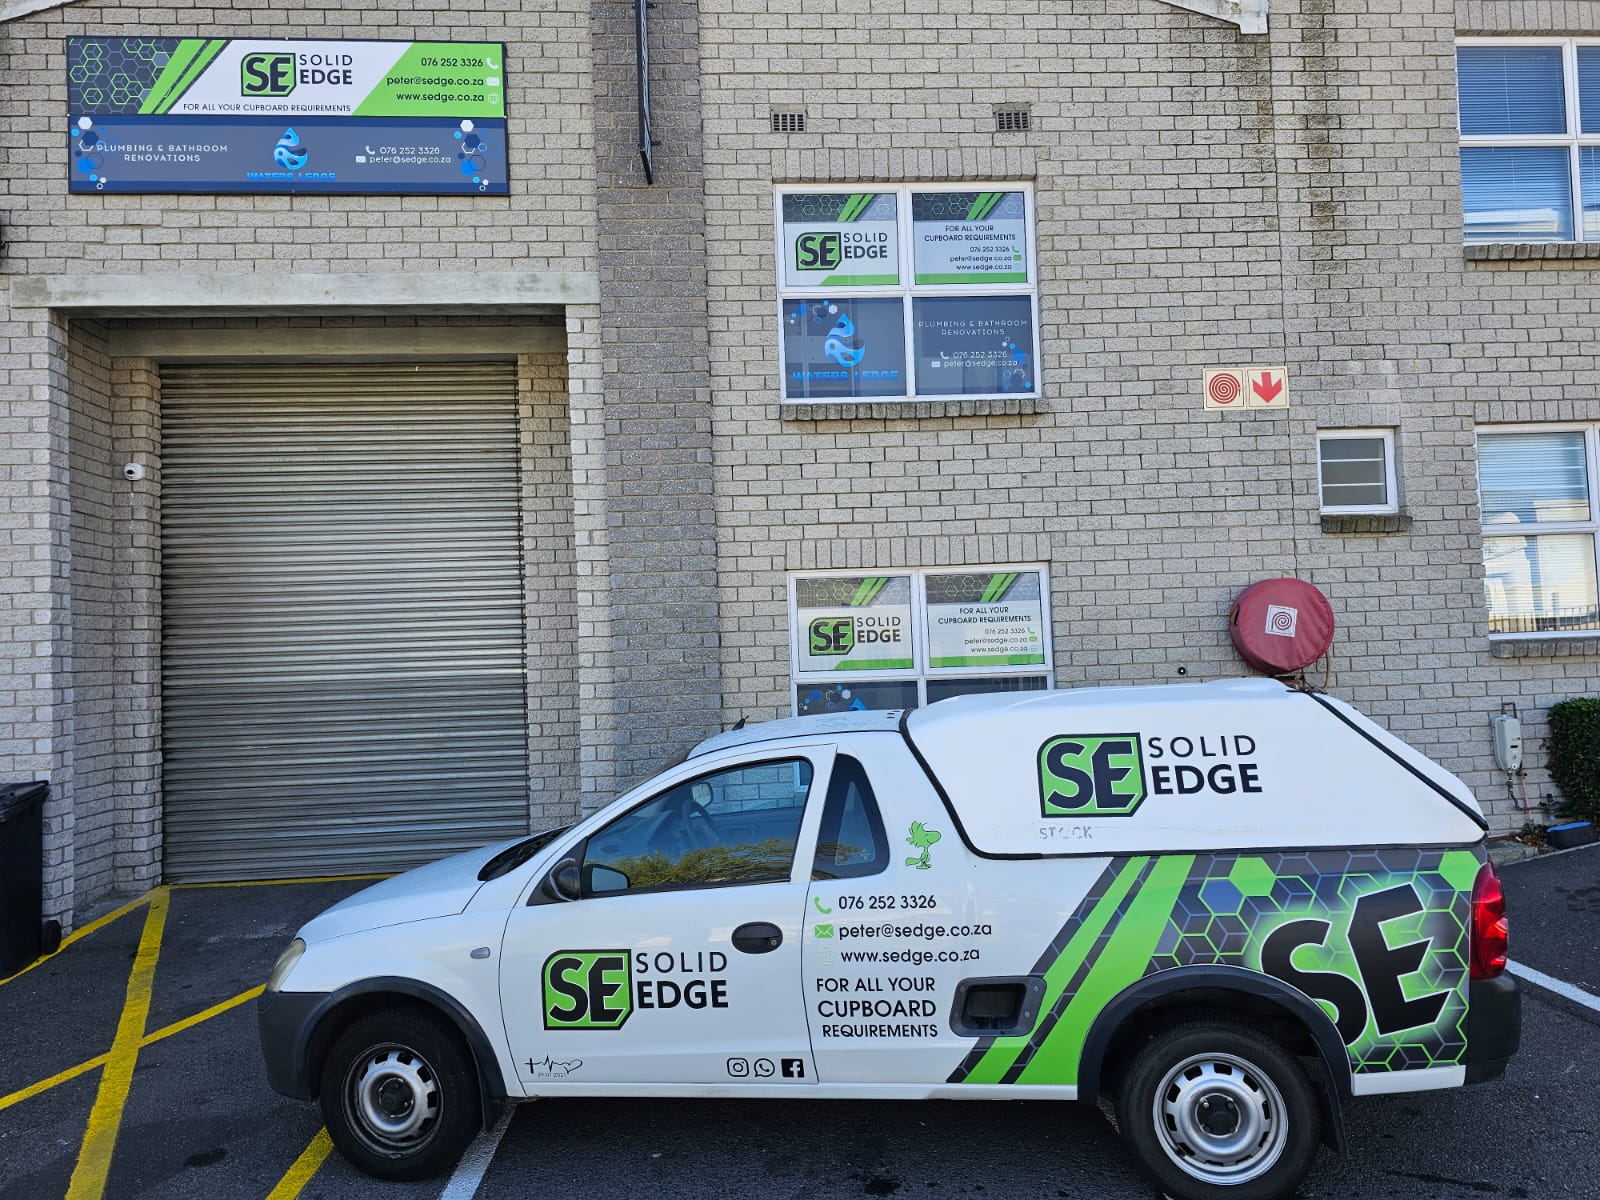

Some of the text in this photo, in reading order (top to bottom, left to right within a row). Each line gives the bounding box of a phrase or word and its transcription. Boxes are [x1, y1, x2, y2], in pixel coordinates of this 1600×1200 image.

[299, 54, 353, 66] SOLID
[420, 58, 483, 67] 076 252 3326
[245, 56, 291, 92] SE
[300, 69, 353, 85] EDGE
[386, 76, 484, 87] peter@sedge.co.za
[396, 93, 484, 103] www.sedge.co.za
[380, 147, 397, 155] 076
[370, 155, 452, 164] peter@sedge.co.za
[246, 172, 294, 182] WATERS
[843, 232, 888, 243] SOLID
[800, 236, 837, 267] SE
[844, 245, 888, 259] EDGE
[792, 371, 848, 382] WATERS
[856, 616, 901, 627] SOLID
[812, 620, 850, 652] SE
[857, 629, 902, 643] EDGE
[1148, 734, 1256, 758] SOLID
[1046, 740, 1136, 810] SE
[1152, 763, 1263, 795] EDGE
[838, 895, 937, 910] 076 252 3326
[839, 923, 992, 941] peter@sedge.co.za
[635, 952, 728, 974] SOLID
[840, 949, 980, 966] www.sedge.co.za
[1259, 882, 1453, 1047] SE
[548, 956, 626, 1023] SE
[816, 977, 936, 992] FOR ALL YOUR
[637, 979, 729, 1009] EDGE
[818, 1000, 936, 1017] CUPBOARD
[822, 1024, 938, 1038] REQUIREMENTS
